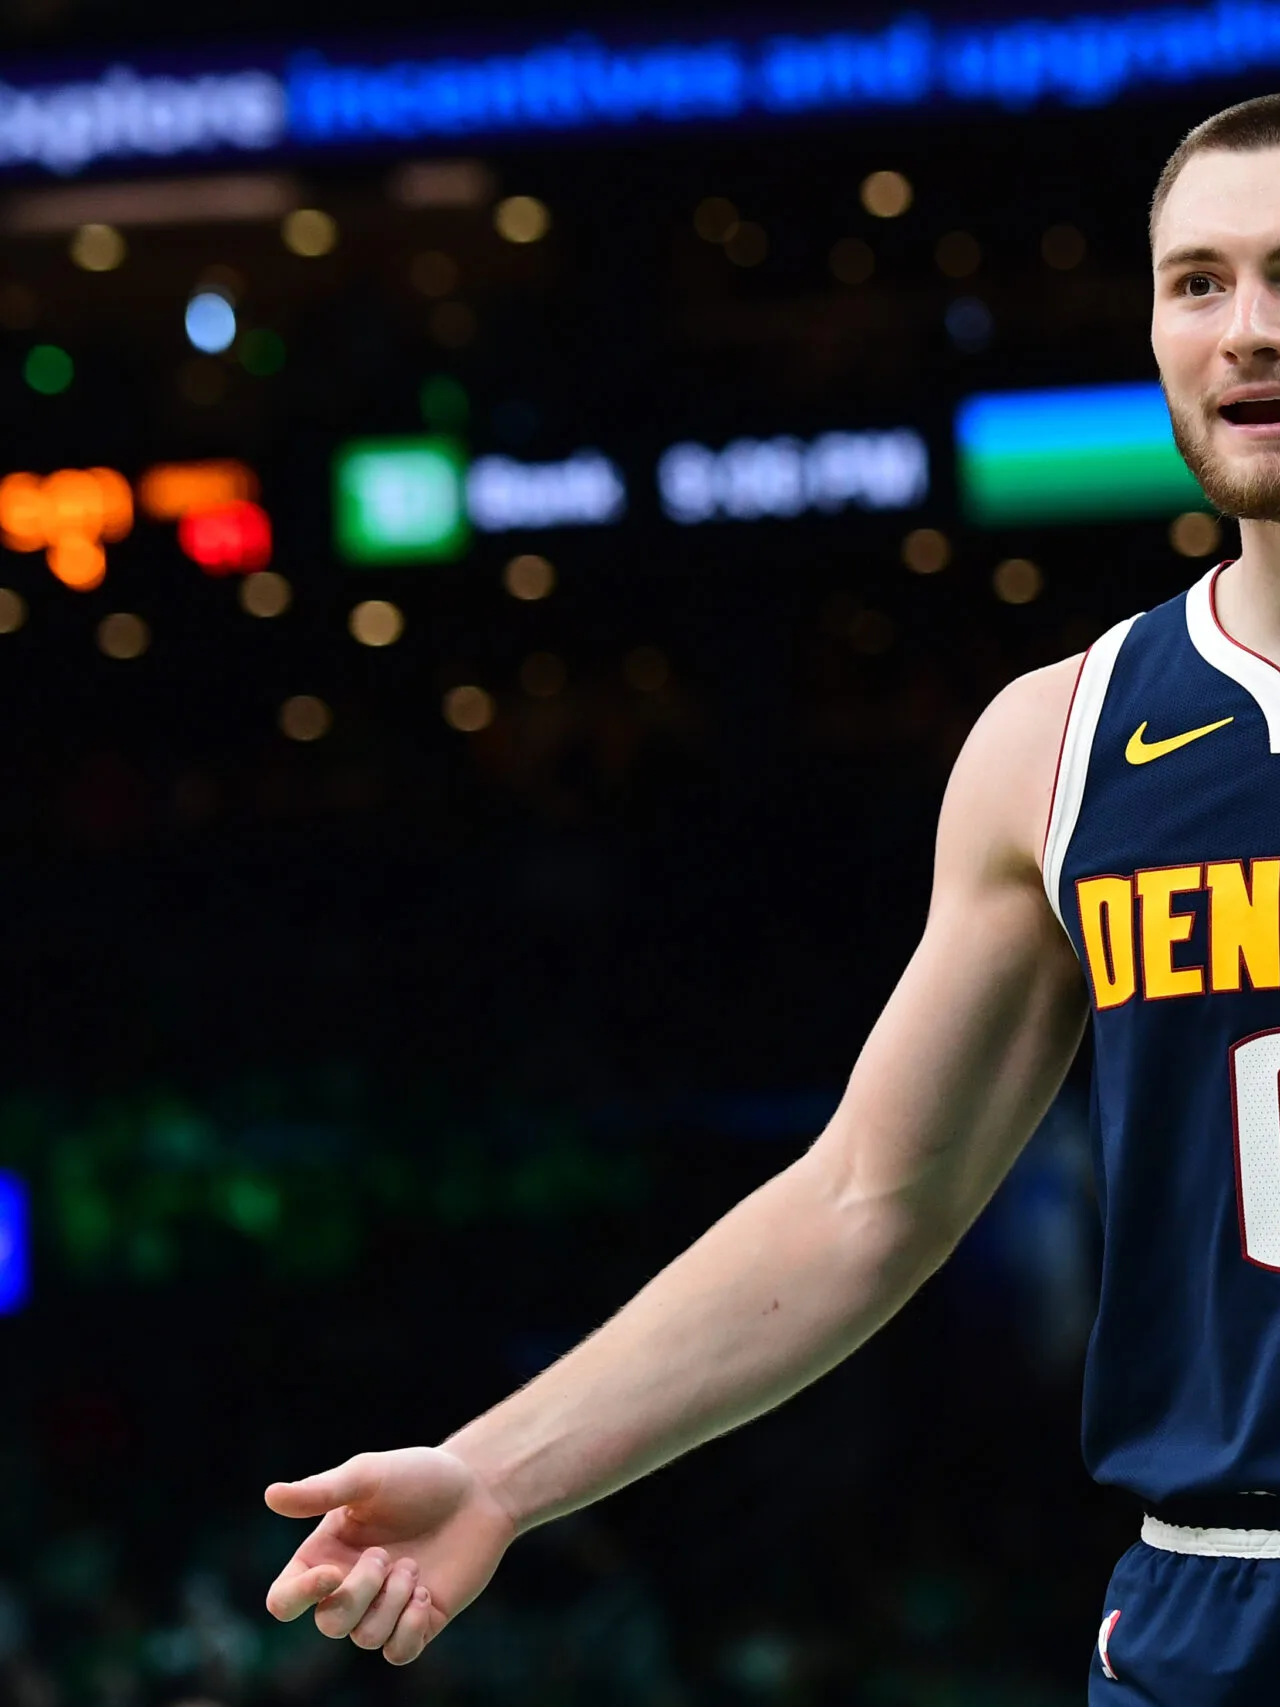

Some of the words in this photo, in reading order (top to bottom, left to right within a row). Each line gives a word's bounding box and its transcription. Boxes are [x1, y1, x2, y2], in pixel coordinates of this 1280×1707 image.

[0, 68, 280, 168] xplore
[288, 42, 739, 141] incentives
[757, 22, 930, 110] and
[466, 458, 623, 528] Bank
[811, 432, 927, 506] PM
